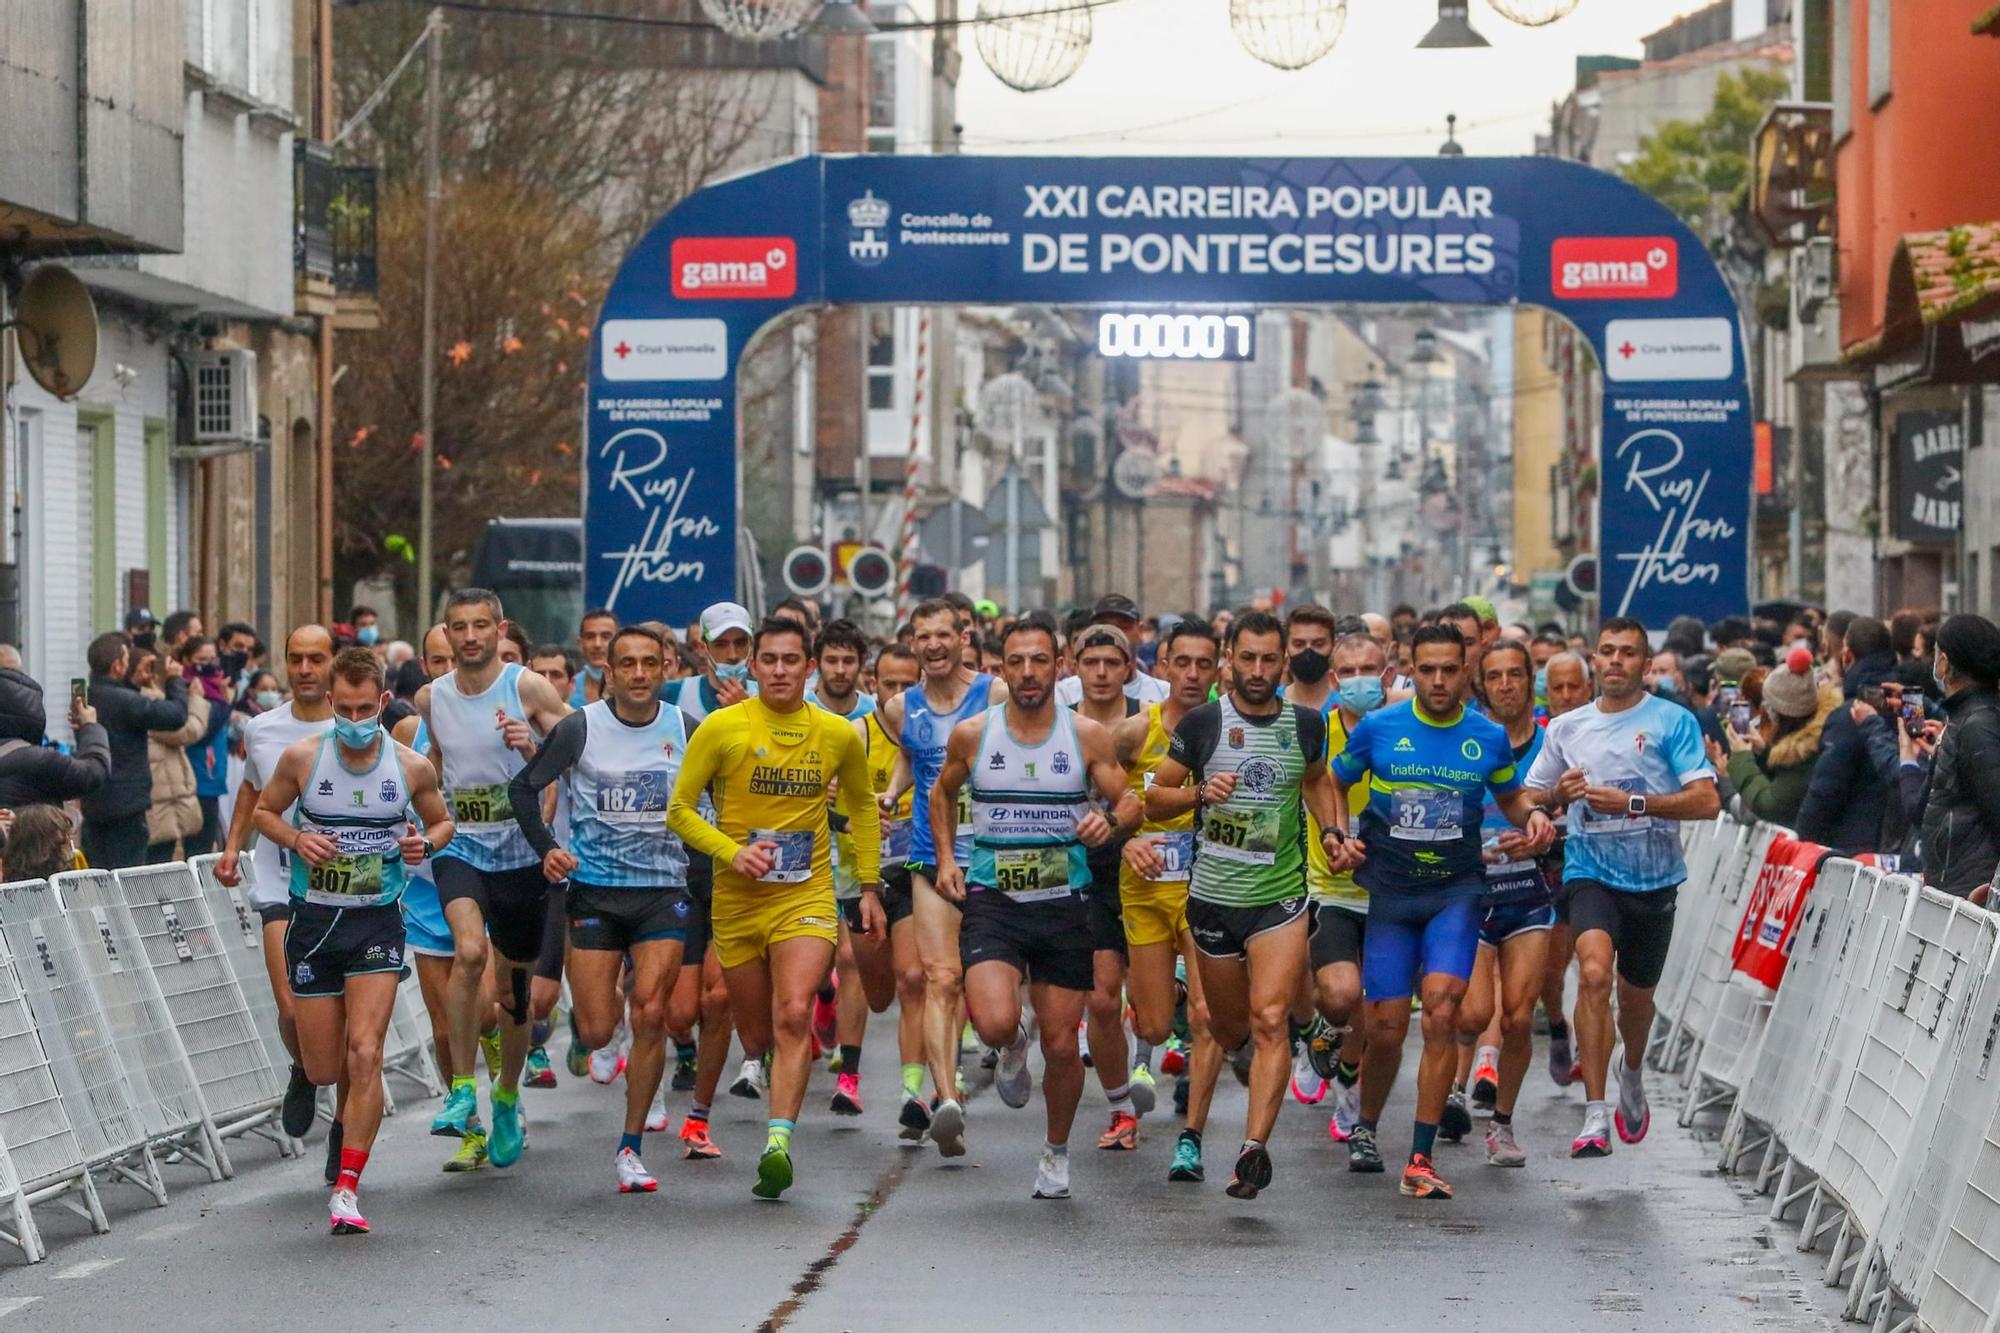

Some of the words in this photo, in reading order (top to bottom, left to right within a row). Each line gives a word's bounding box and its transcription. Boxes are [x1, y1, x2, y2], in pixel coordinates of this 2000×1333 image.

[1024, 186, 1088, 217] XXI
[1097, 186, 1300, 218] CARREIRA
[1307, 186, 1493, 218] POPULAR
[901, 213, 969, 227] Concello
[971, 214, 992, 228] de
[901, 230, 1010, 245] Pontecesures
[1023, 234, 1089, 273] DE
[1101, 233, 1495, 274] PONTECESURES
[682, 262, 766, 289] gama
[1562, 261, 1648, 289] gama
[637, 344, 662, 354] Cruz
[1641, 344, 1668, 354] Cruz
[610, 410, 624, 421] DE
[627, 410, 711, 421] PONTECESURES
[617, 399, 670, 410] CARREIRA
[672, 399, 723, 410] POPULAR
[1633, 400, 1687, 410] CARREIRA
[1689, 400, 1740, 411] POPULAR
[1626, 411, 1641, 421] DE
[1643, 411, 1728, 422] PONTECESURES
[600, 427, 678, 511] Run
[1616, 428, 1693, 511] Run
[752, 766, 822, 782] ATHLETICS
[750, 781, 775, 795] SAN
[601, 787, 637, 812] 182
[457, 800, 490, 822] 367
[1400, 803, 1426, 828] 32
[1207, 819, 1247, 849] 337
[310, 867, 351, 893] 307
[998, 866, 1040, 893] 354
[1491, 879, 1536, 894] SANTIAGO
